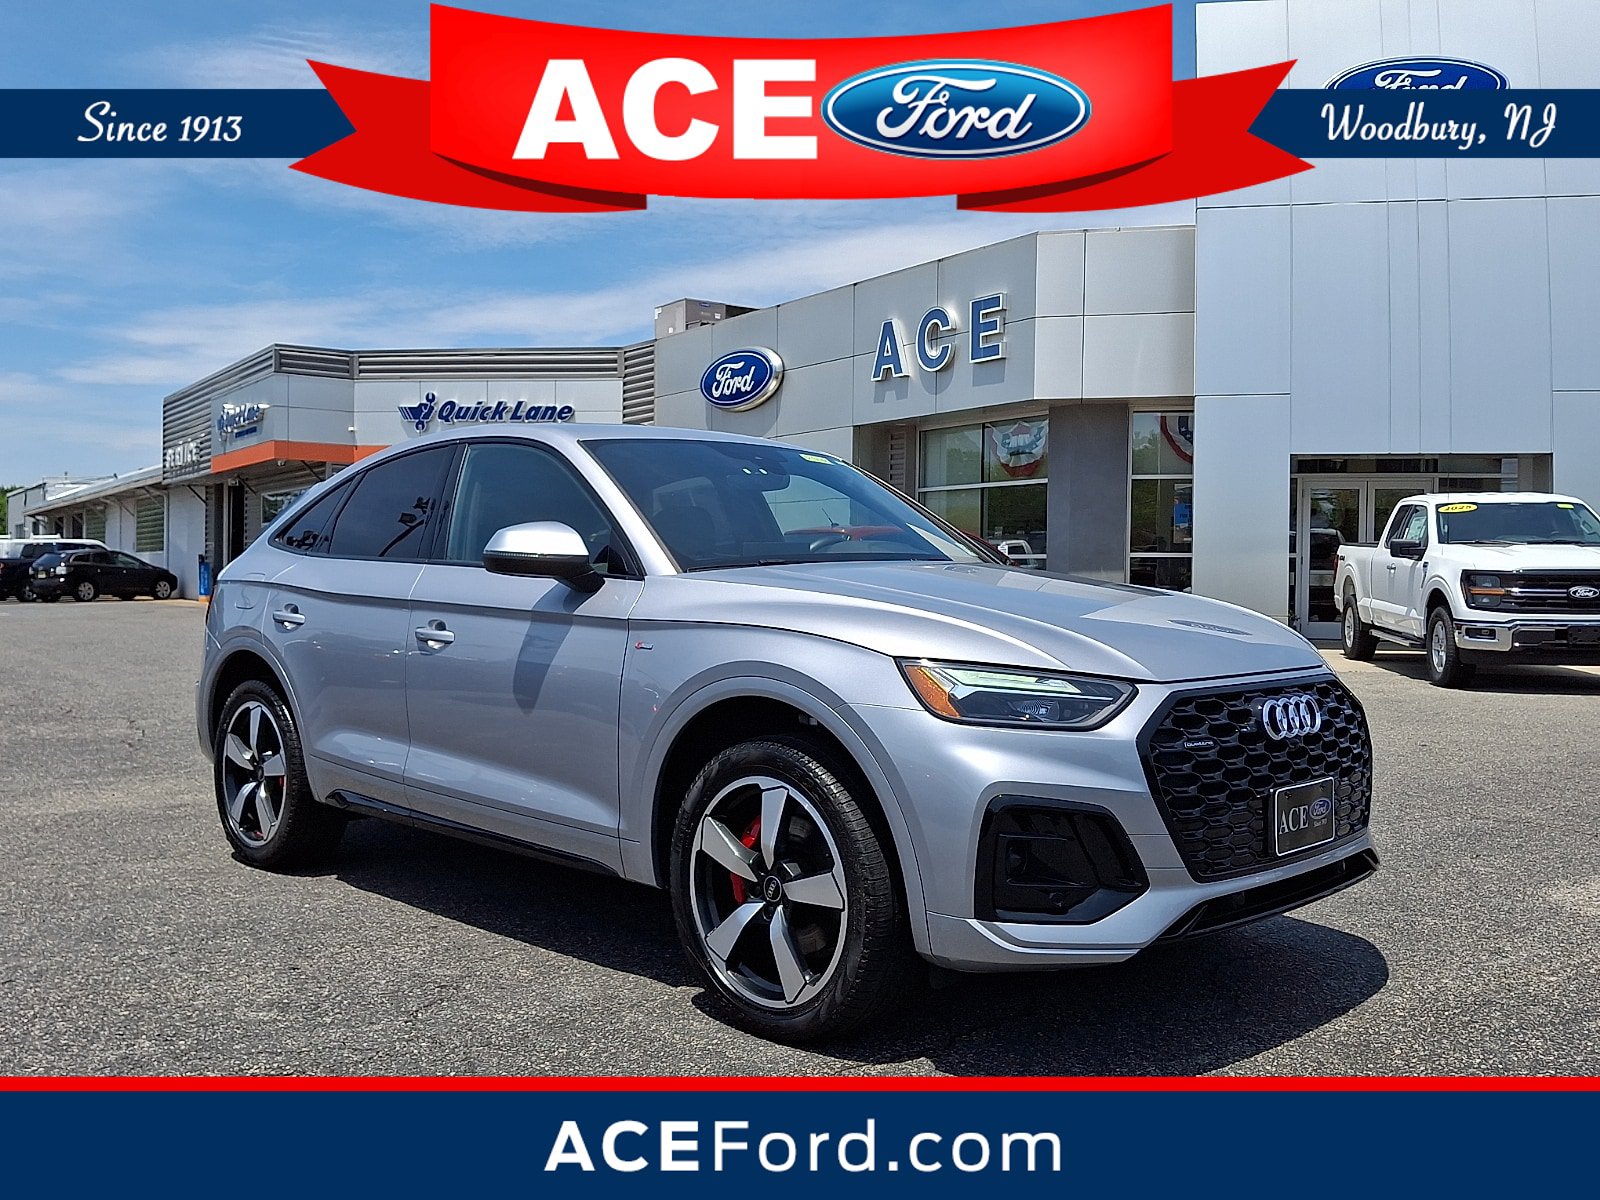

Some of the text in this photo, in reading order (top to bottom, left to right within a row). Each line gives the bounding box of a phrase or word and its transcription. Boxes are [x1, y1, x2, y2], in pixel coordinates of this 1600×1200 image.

[871, 292, 1007, 382] ACE
[712, 360, 755, 397] Ford
[437, 400, 575, 423] Quick Lane
[1279, 805, 1309, 835] ACE
